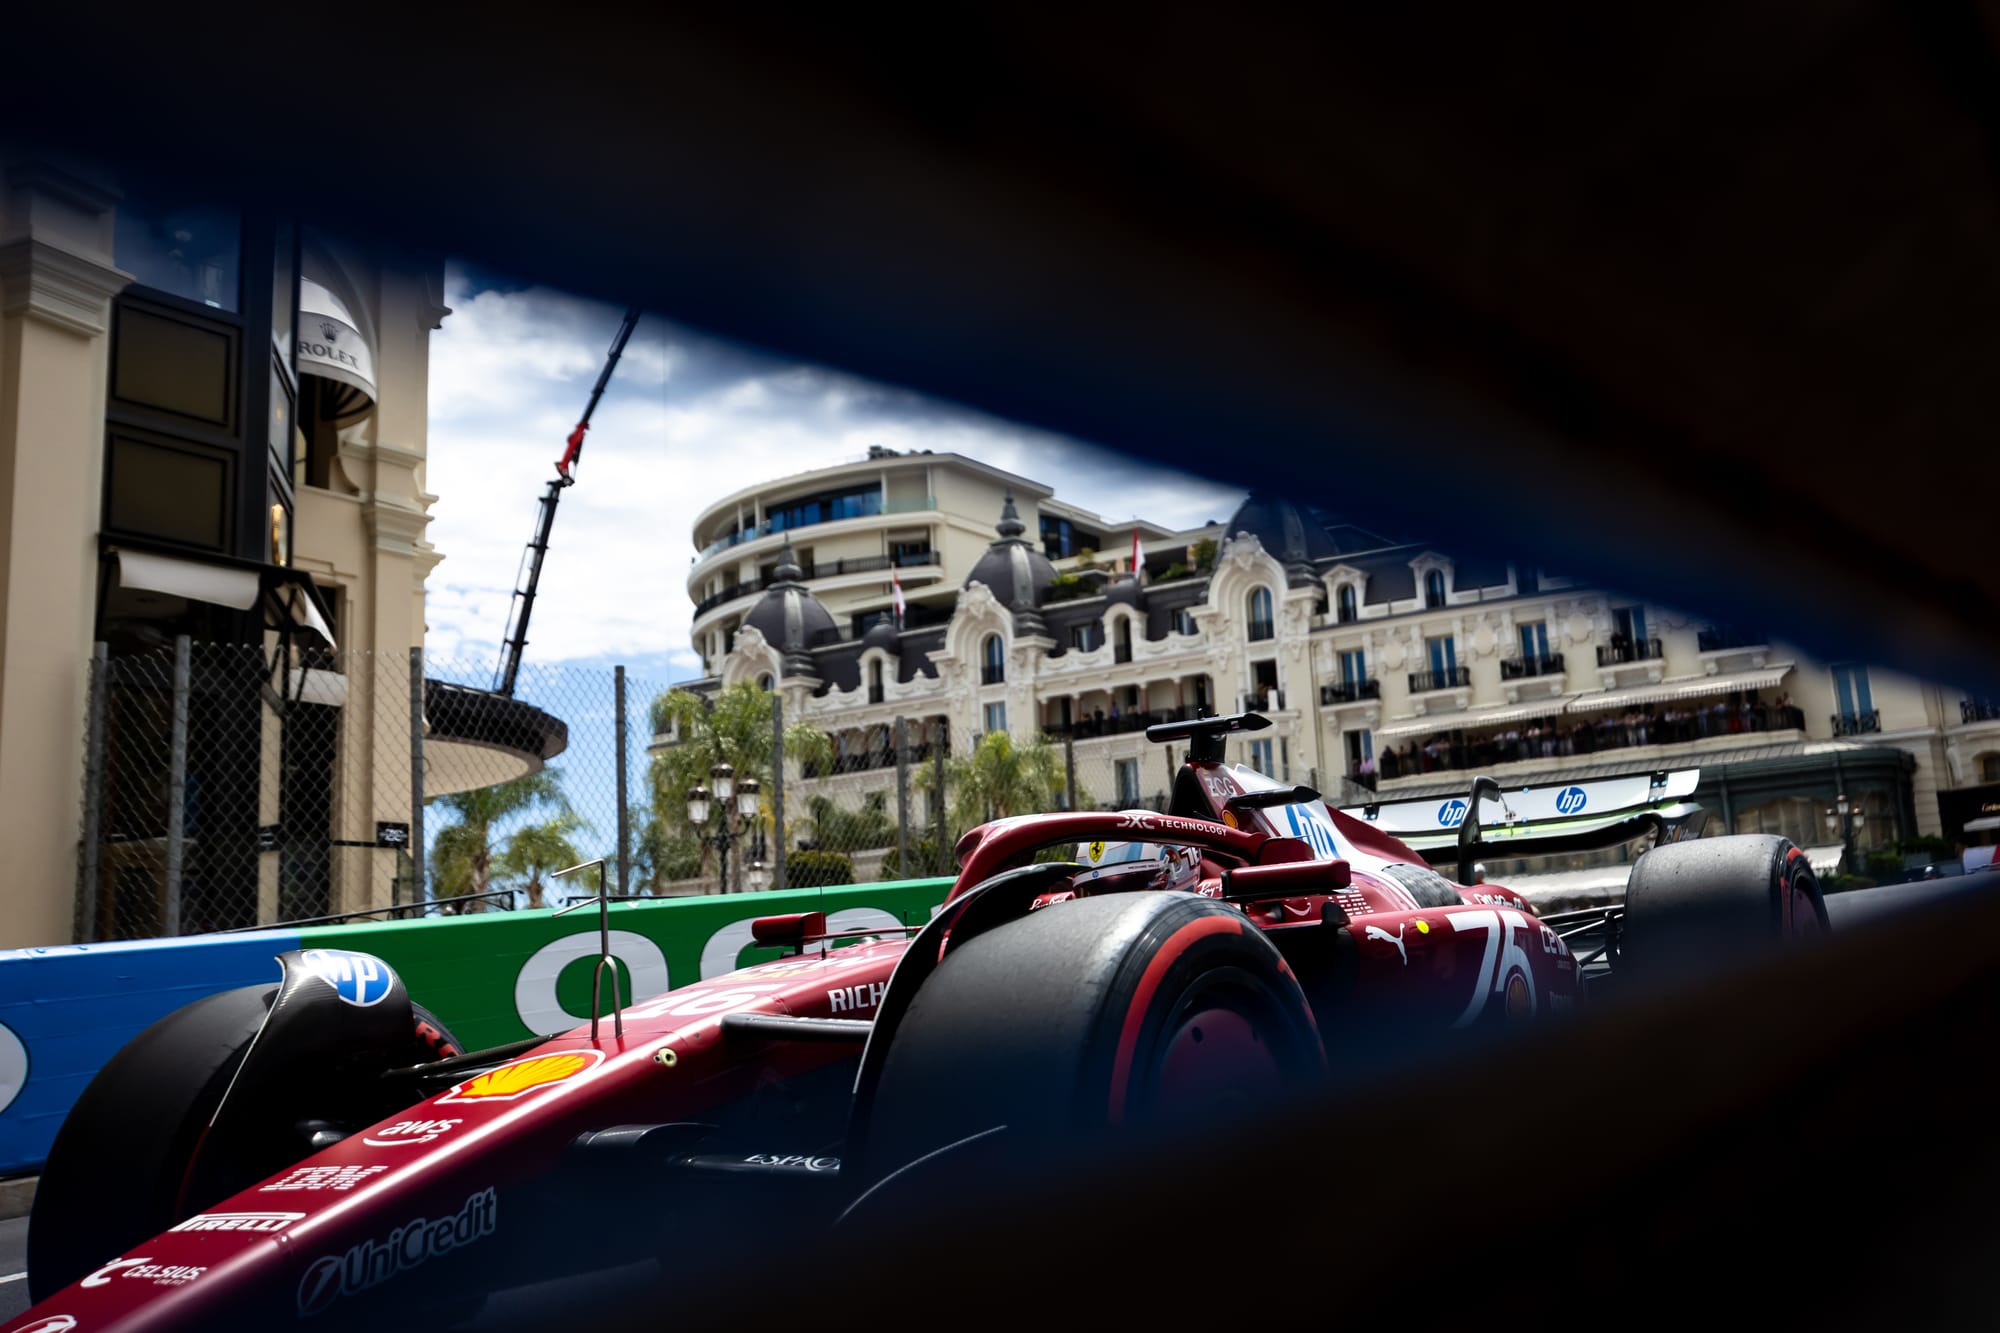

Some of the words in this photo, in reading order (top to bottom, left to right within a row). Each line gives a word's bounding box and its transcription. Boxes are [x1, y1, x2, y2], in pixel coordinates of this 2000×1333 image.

[299, 341, 359, 370] ROLEX
[1441, 800, 1466, 827] hp
[1559, 787, 1585, 814] hp
[1158, 818, 1227, 836] TECHNOLOGY
[377, 1118, 463, 1137] aws
[259, 1165, 388, 1192] IBM
[168, 1212, 306, 1232] PIRELLI
[341, 1186, 497, 1296] UniCredit
[122, 1265, 207, 1281] CELSIUS
